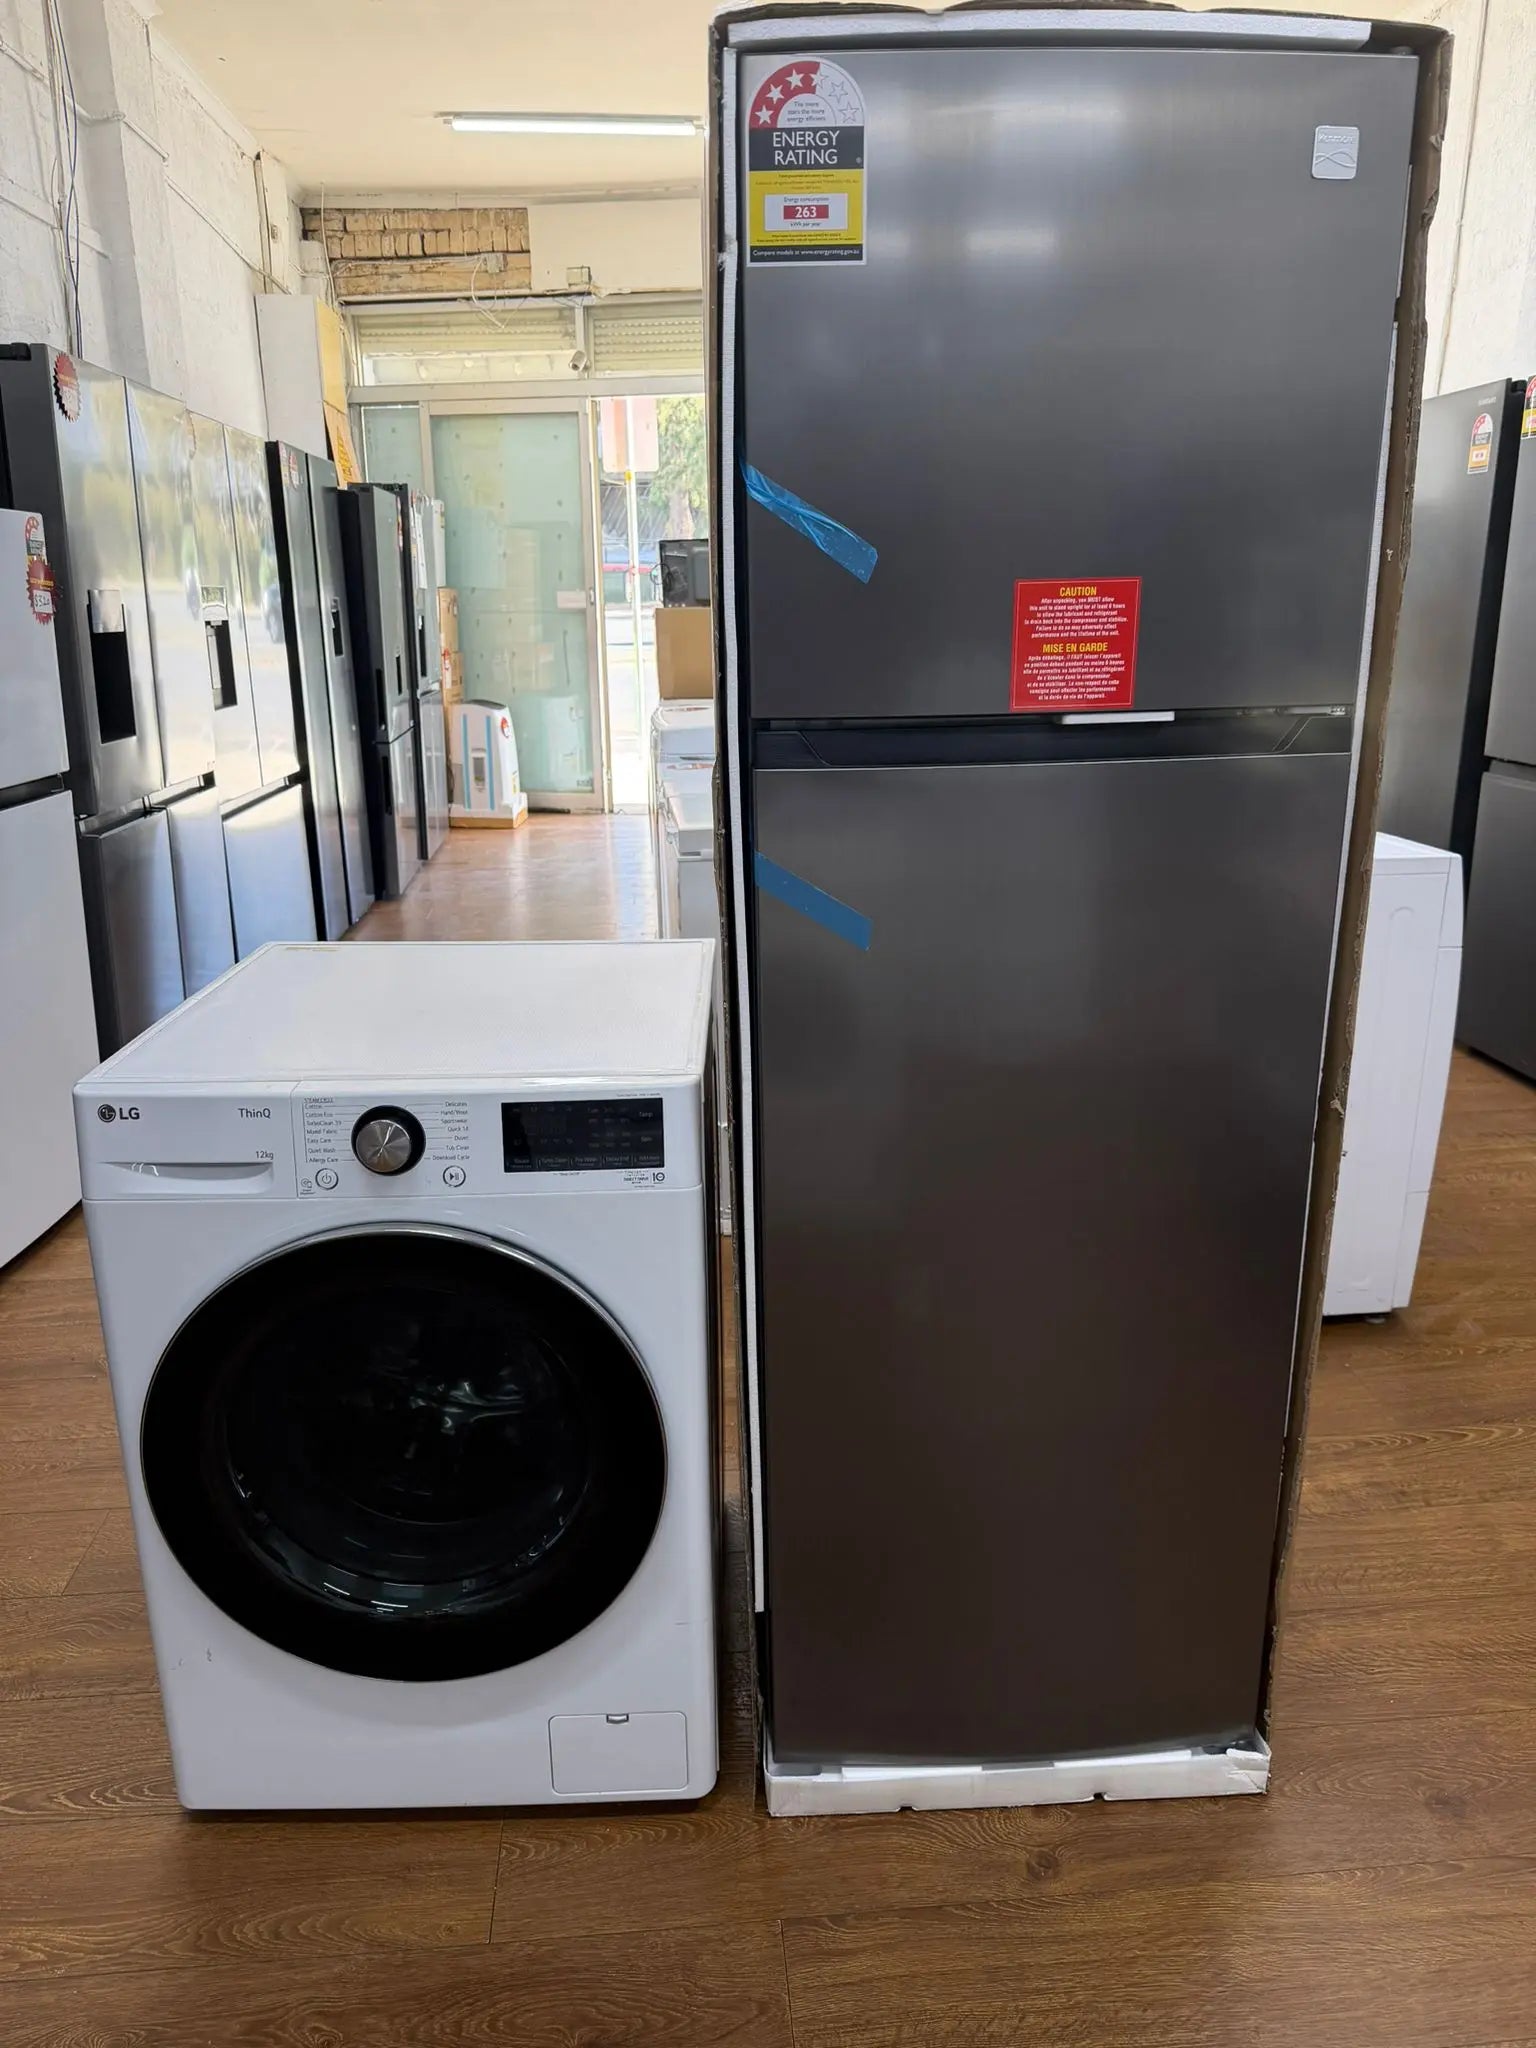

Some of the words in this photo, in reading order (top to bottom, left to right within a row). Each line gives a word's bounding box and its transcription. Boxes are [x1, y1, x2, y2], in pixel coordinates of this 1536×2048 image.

[773, 131, 840, 147] ENERGY
[775, 149, 838, 165] RATING
[795, 207, 816, 218] 263
[1060, 586, 1097, 597] CAUTION
[1042, 643, 1064, 653] MISE
[1066, 643, 1077, 652] EN
[1080, 642, 1108, 652] GARDE
[119, 1107, 140, 1120] LG
[238, 1108, 271, 1119] ThinQ
[255, 1150, 273, 1160] 12kg
